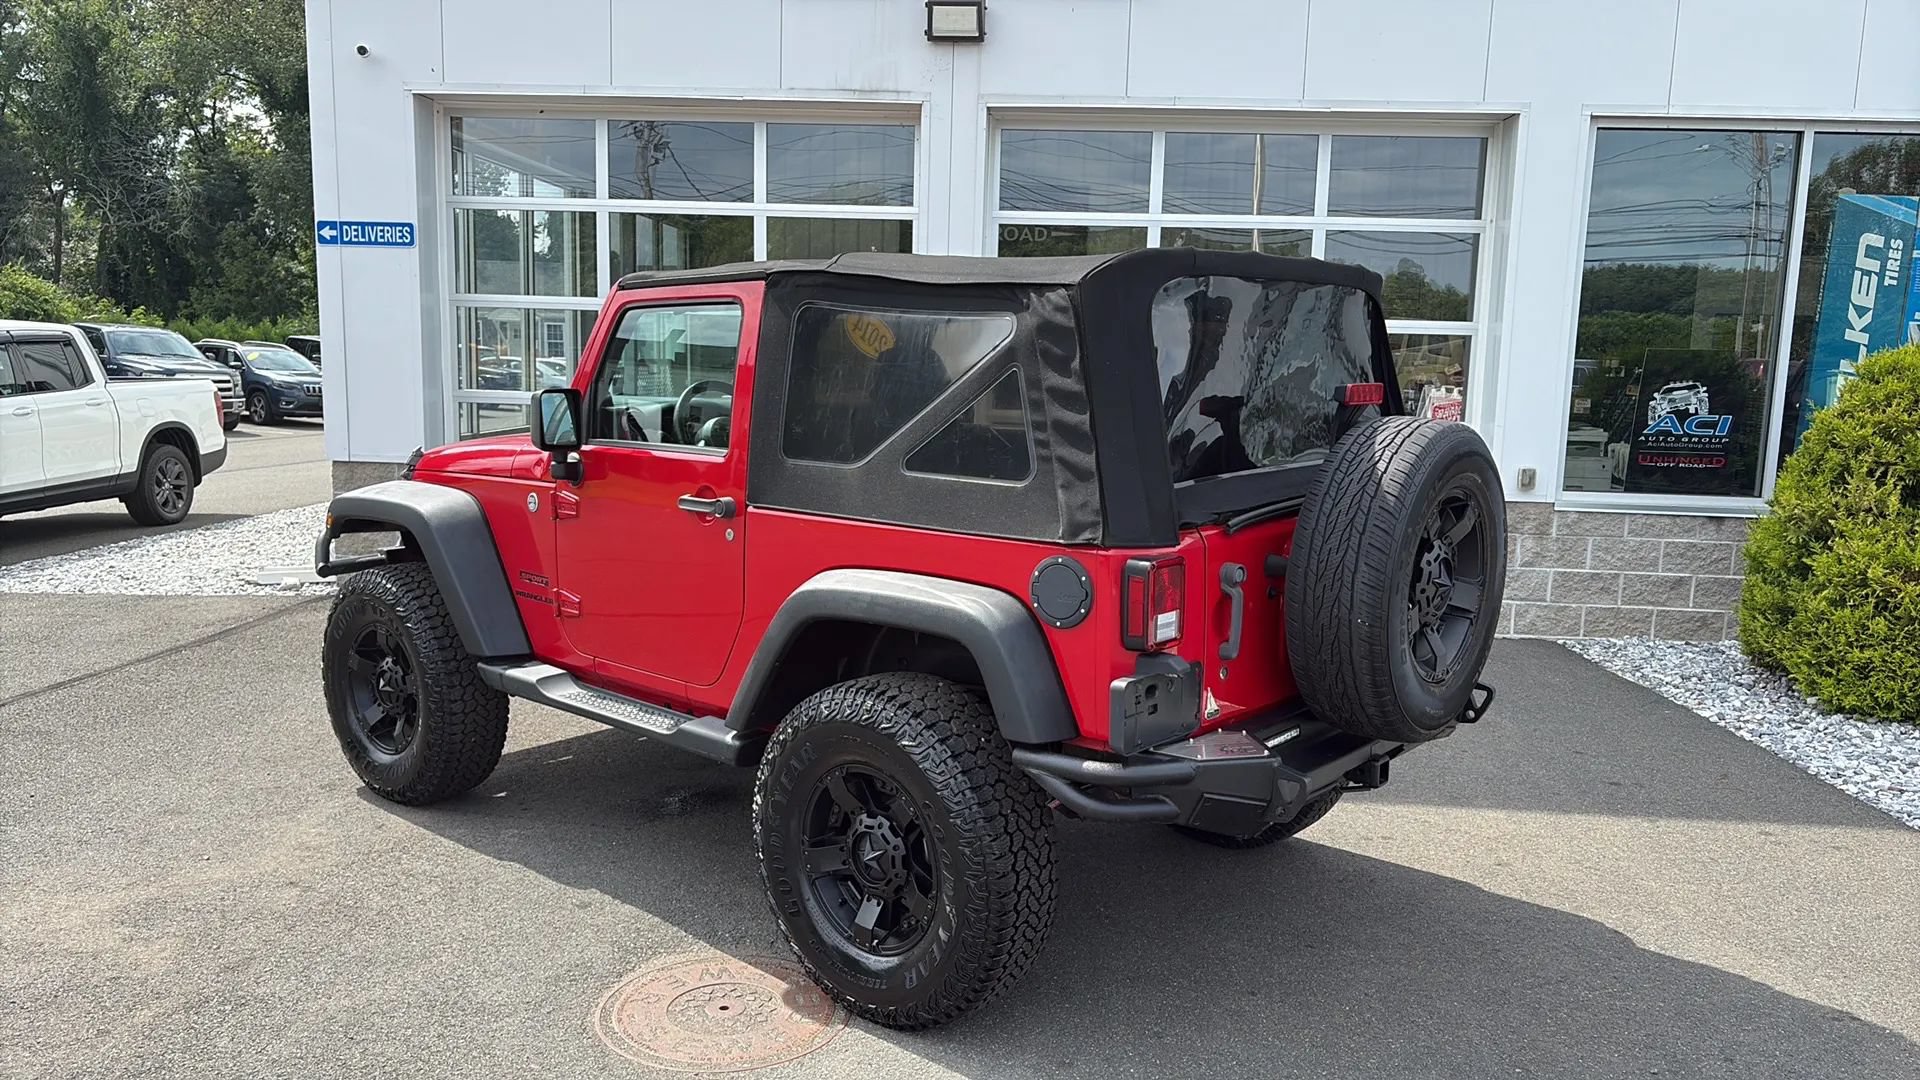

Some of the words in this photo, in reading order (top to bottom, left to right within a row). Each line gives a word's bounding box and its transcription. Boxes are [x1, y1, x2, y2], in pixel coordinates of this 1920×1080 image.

[342, 225, 411, 242] DELIVERIES
[1884, 238, 1904, 287] TIRES
[1642, 414, 1733, 435] ACI
